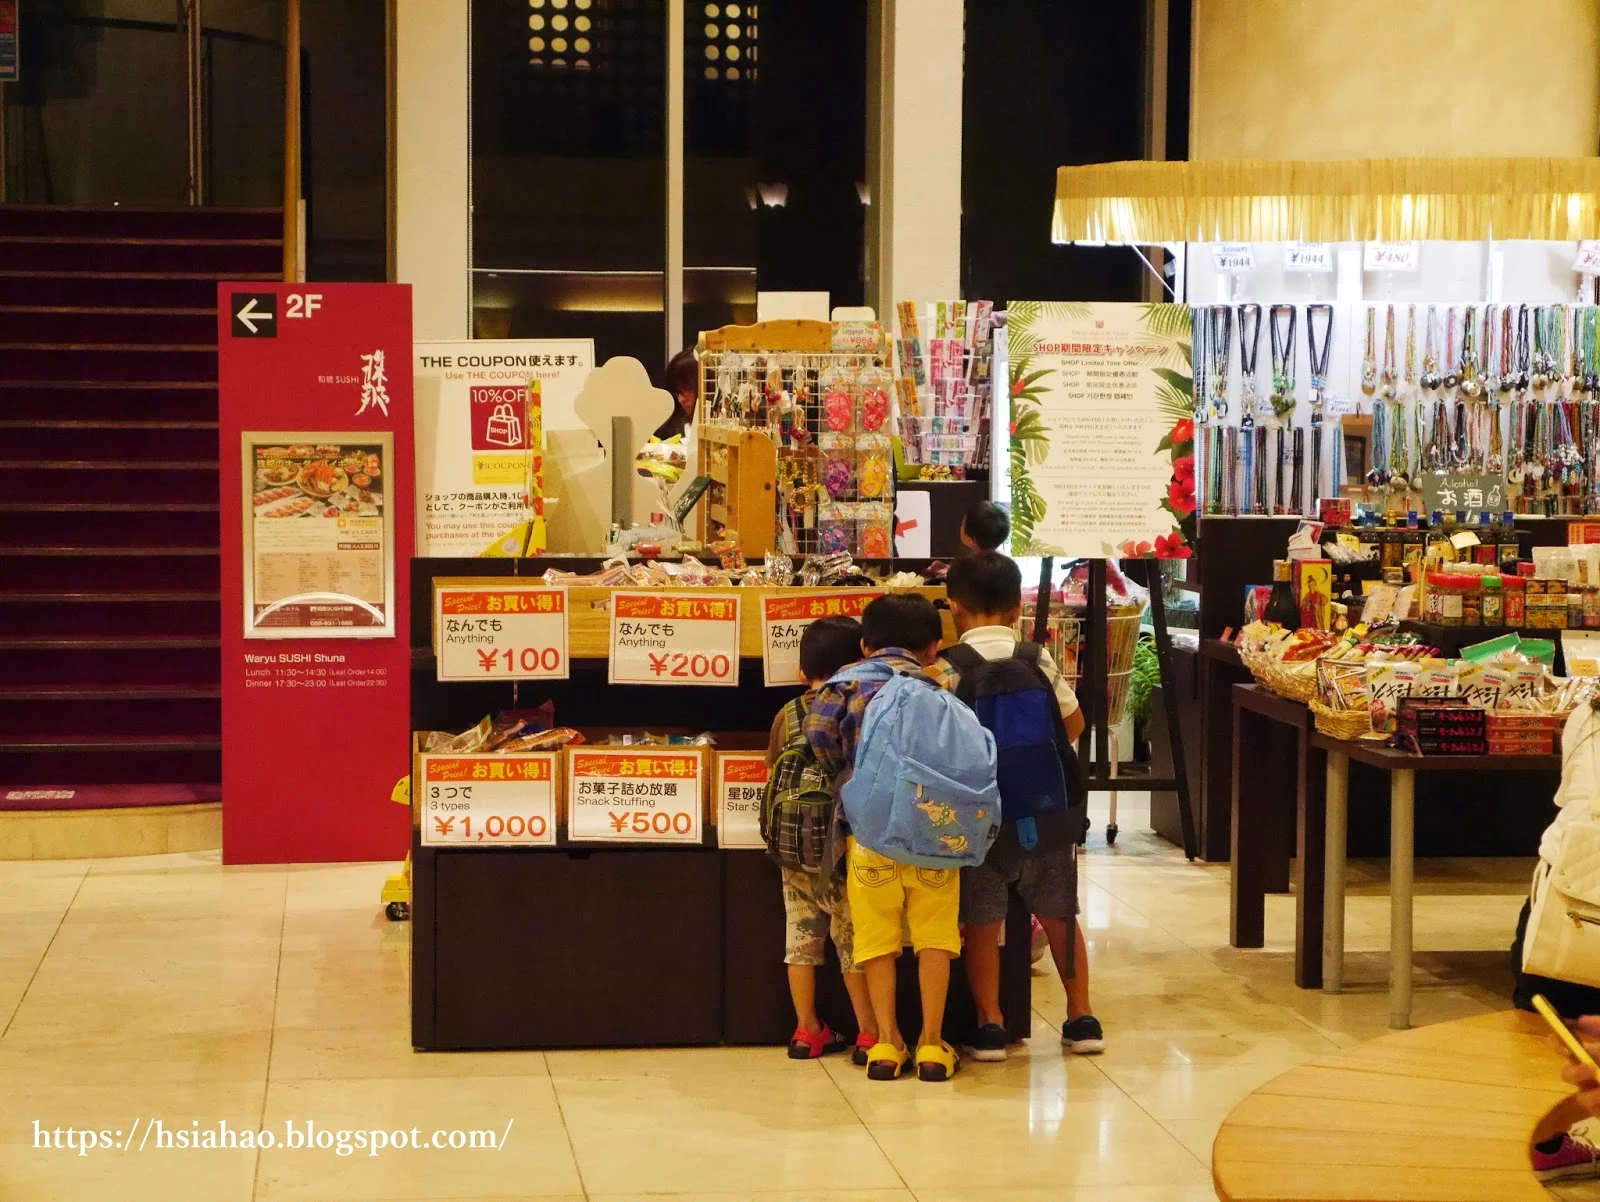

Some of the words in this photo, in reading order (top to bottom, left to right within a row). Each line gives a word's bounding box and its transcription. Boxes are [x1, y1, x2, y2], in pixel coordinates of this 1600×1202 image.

[1220, 257, 1250, 267] ¥1944
[1291, 252, 1324, 263] ¥1944
[286, 294, 323, 318] 2F
[1033, 343, 1168, 356] SHOP期間限定キャンペーン
[420, 356, 453, 368] THE
[335, 375, 360, 384] SUSHI
[445, 371, 464, 380] Use
[467, 371, 486, 380] THE
[489, 371, 533, 380] COUPON
[536, 371, 560, 379] here!
[1440, 477, 1479, 489] Alcohol
[1436, 488, 1483, 507] お酒
[443, 523, 460, 531] may
[480, 521, 495, 529] this
[426, 532, 468, 541] purchases
[481, 531, 495, 539] the
[444, 594, 475, 608] Special
[487, 594, 561, 611] お買い得!
[619, 598, 649, 610] Special
[767, 600, 798, 614] Special
[660, 600, 733, 618] お買い得!
[446, 619, 503, 632] なんでも
[619, 622, 675, 636] なんでも
[446, 634, 494, 644] Anything
[618, 637, 666, 649] Anything
[244, 654, 276, 664] Waryu
[279, 653, 311, 663] SUSHI
[314, 653, 346, 663] Shuna
[477, 647, 560, 672] ¥100
[648, 653, 730, 678] ¥200
[429, 761, 460, 774] Special
[577, 755, 607, 769] Special
[619, 759, 694, 776] お買い得!
[727, 762, 756, 775] Special
[472, 762, 547, 779] お買い得!
[578, 781, 678, 796] お菓子詰め放題
[430, 801, 438, 811] 3
[441, 801, 470, 811] types
[577, 795, 610, 806] Snack
[612, 797, 656, 808] Stuffing
[727, 802, 749, 812] Star
[433, 815, 547, 841] ¥1,000
[608, 811, 692, 835] ¥500
